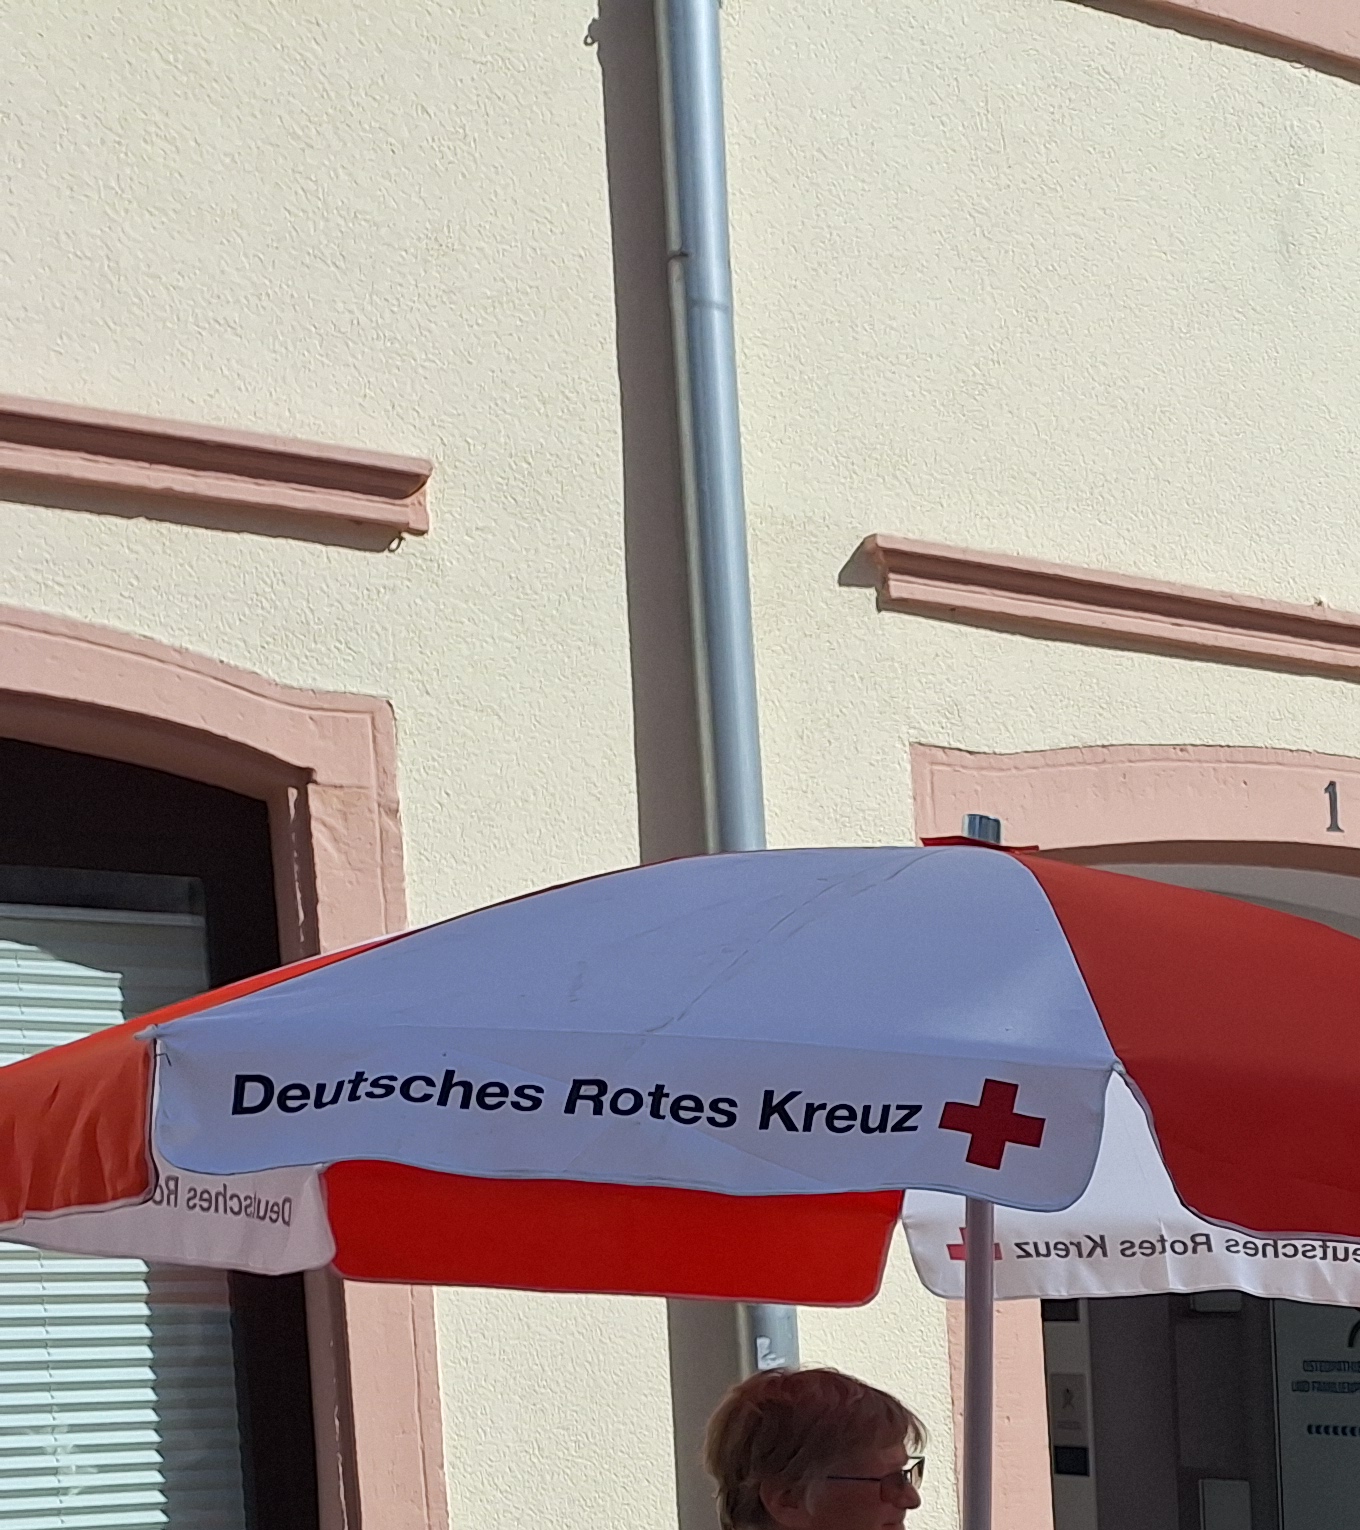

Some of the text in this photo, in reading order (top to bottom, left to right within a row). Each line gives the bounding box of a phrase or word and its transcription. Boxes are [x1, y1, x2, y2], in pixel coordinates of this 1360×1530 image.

[1324, 780, 1345, 833] 1
[231, 1068, 924, 1135] Deutsches Rotes Kreuz
